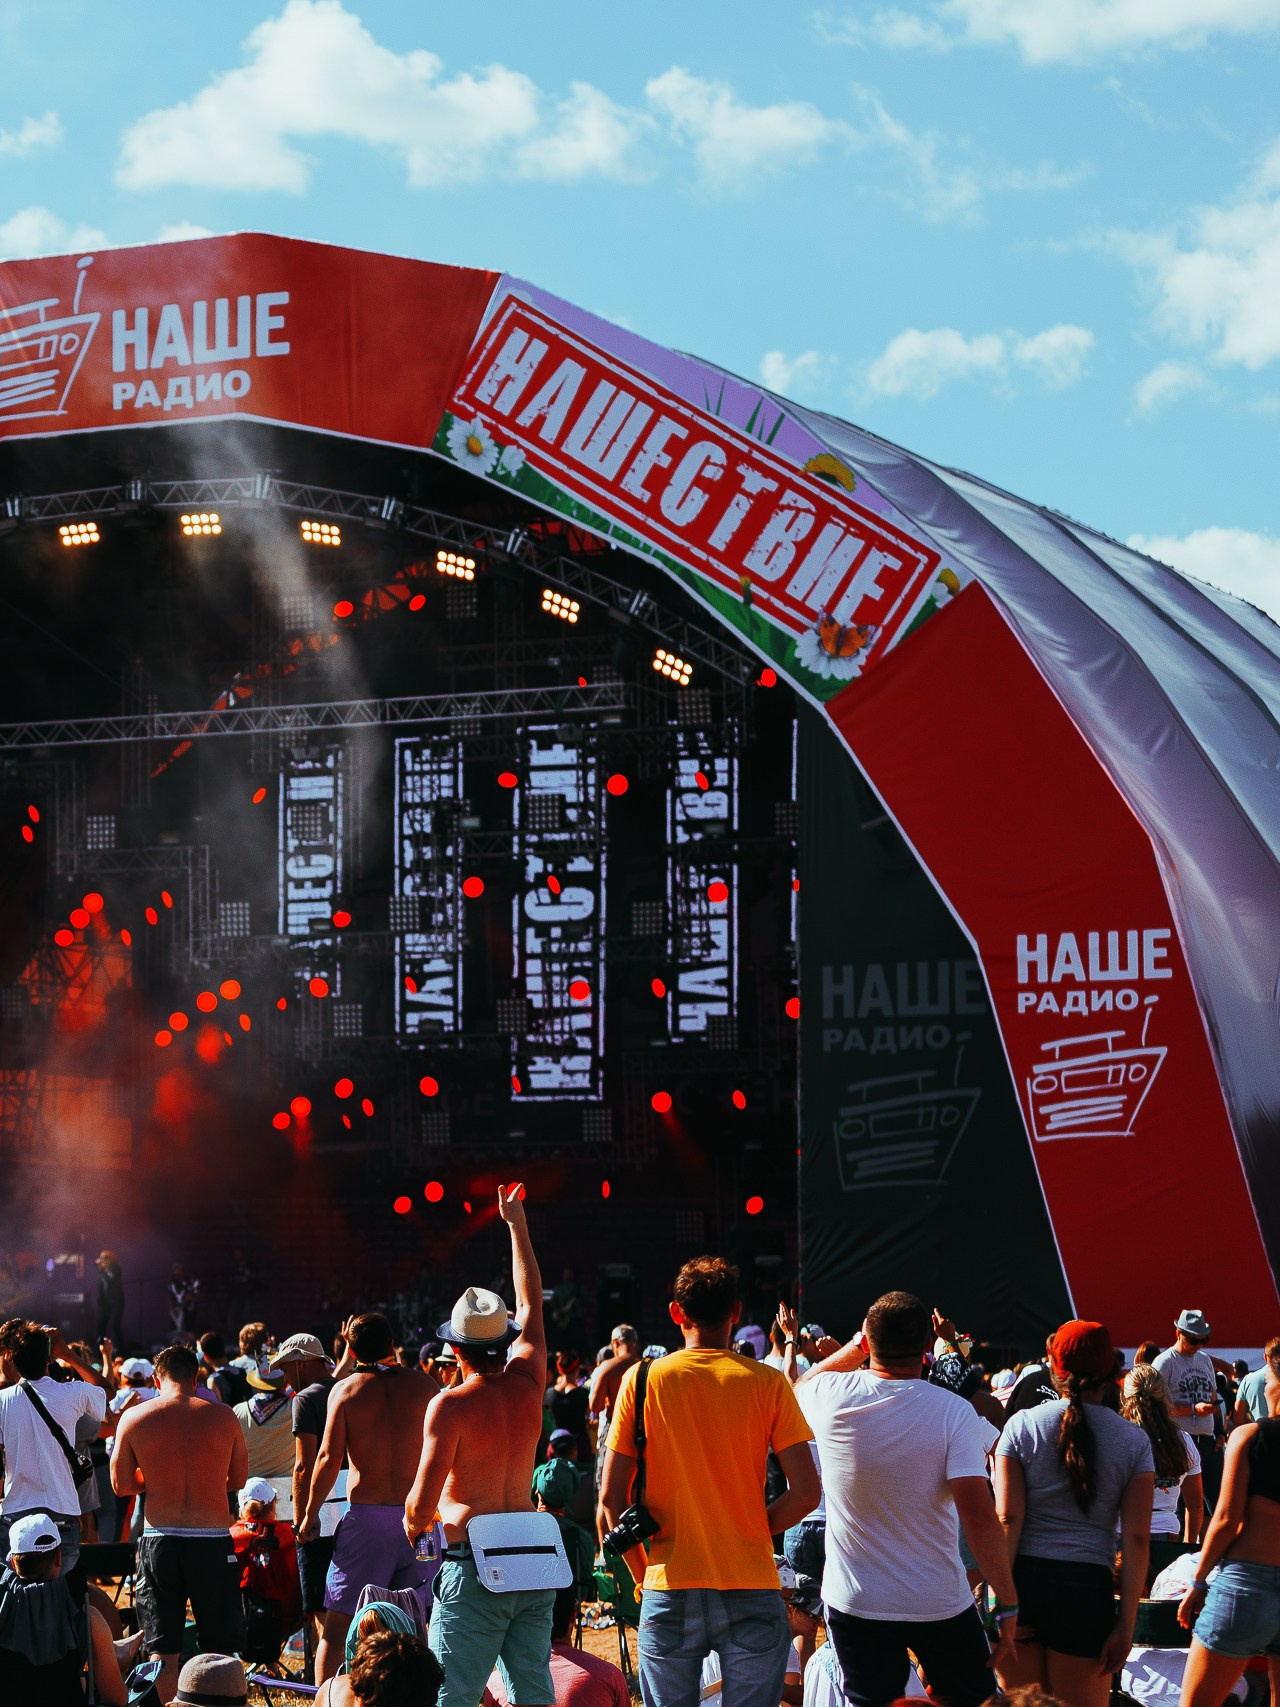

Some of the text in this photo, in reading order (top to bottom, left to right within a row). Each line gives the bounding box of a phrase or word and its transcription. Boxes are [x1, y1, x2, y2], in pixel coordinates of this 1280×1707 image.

[112, 291, 290, 373] НАШЕ
[112, 369, 251, 411] РАДИО
[475, 327, 903, 626] НАШЕСТВИЕ
[1016, 928, 1173, 984] НАШЕ
[821, 960, 987, 1020] НАШЕ
[1017, 988, 1139, 1017] РАДИО
[823, 1024, 951, 1055] РАДИО
